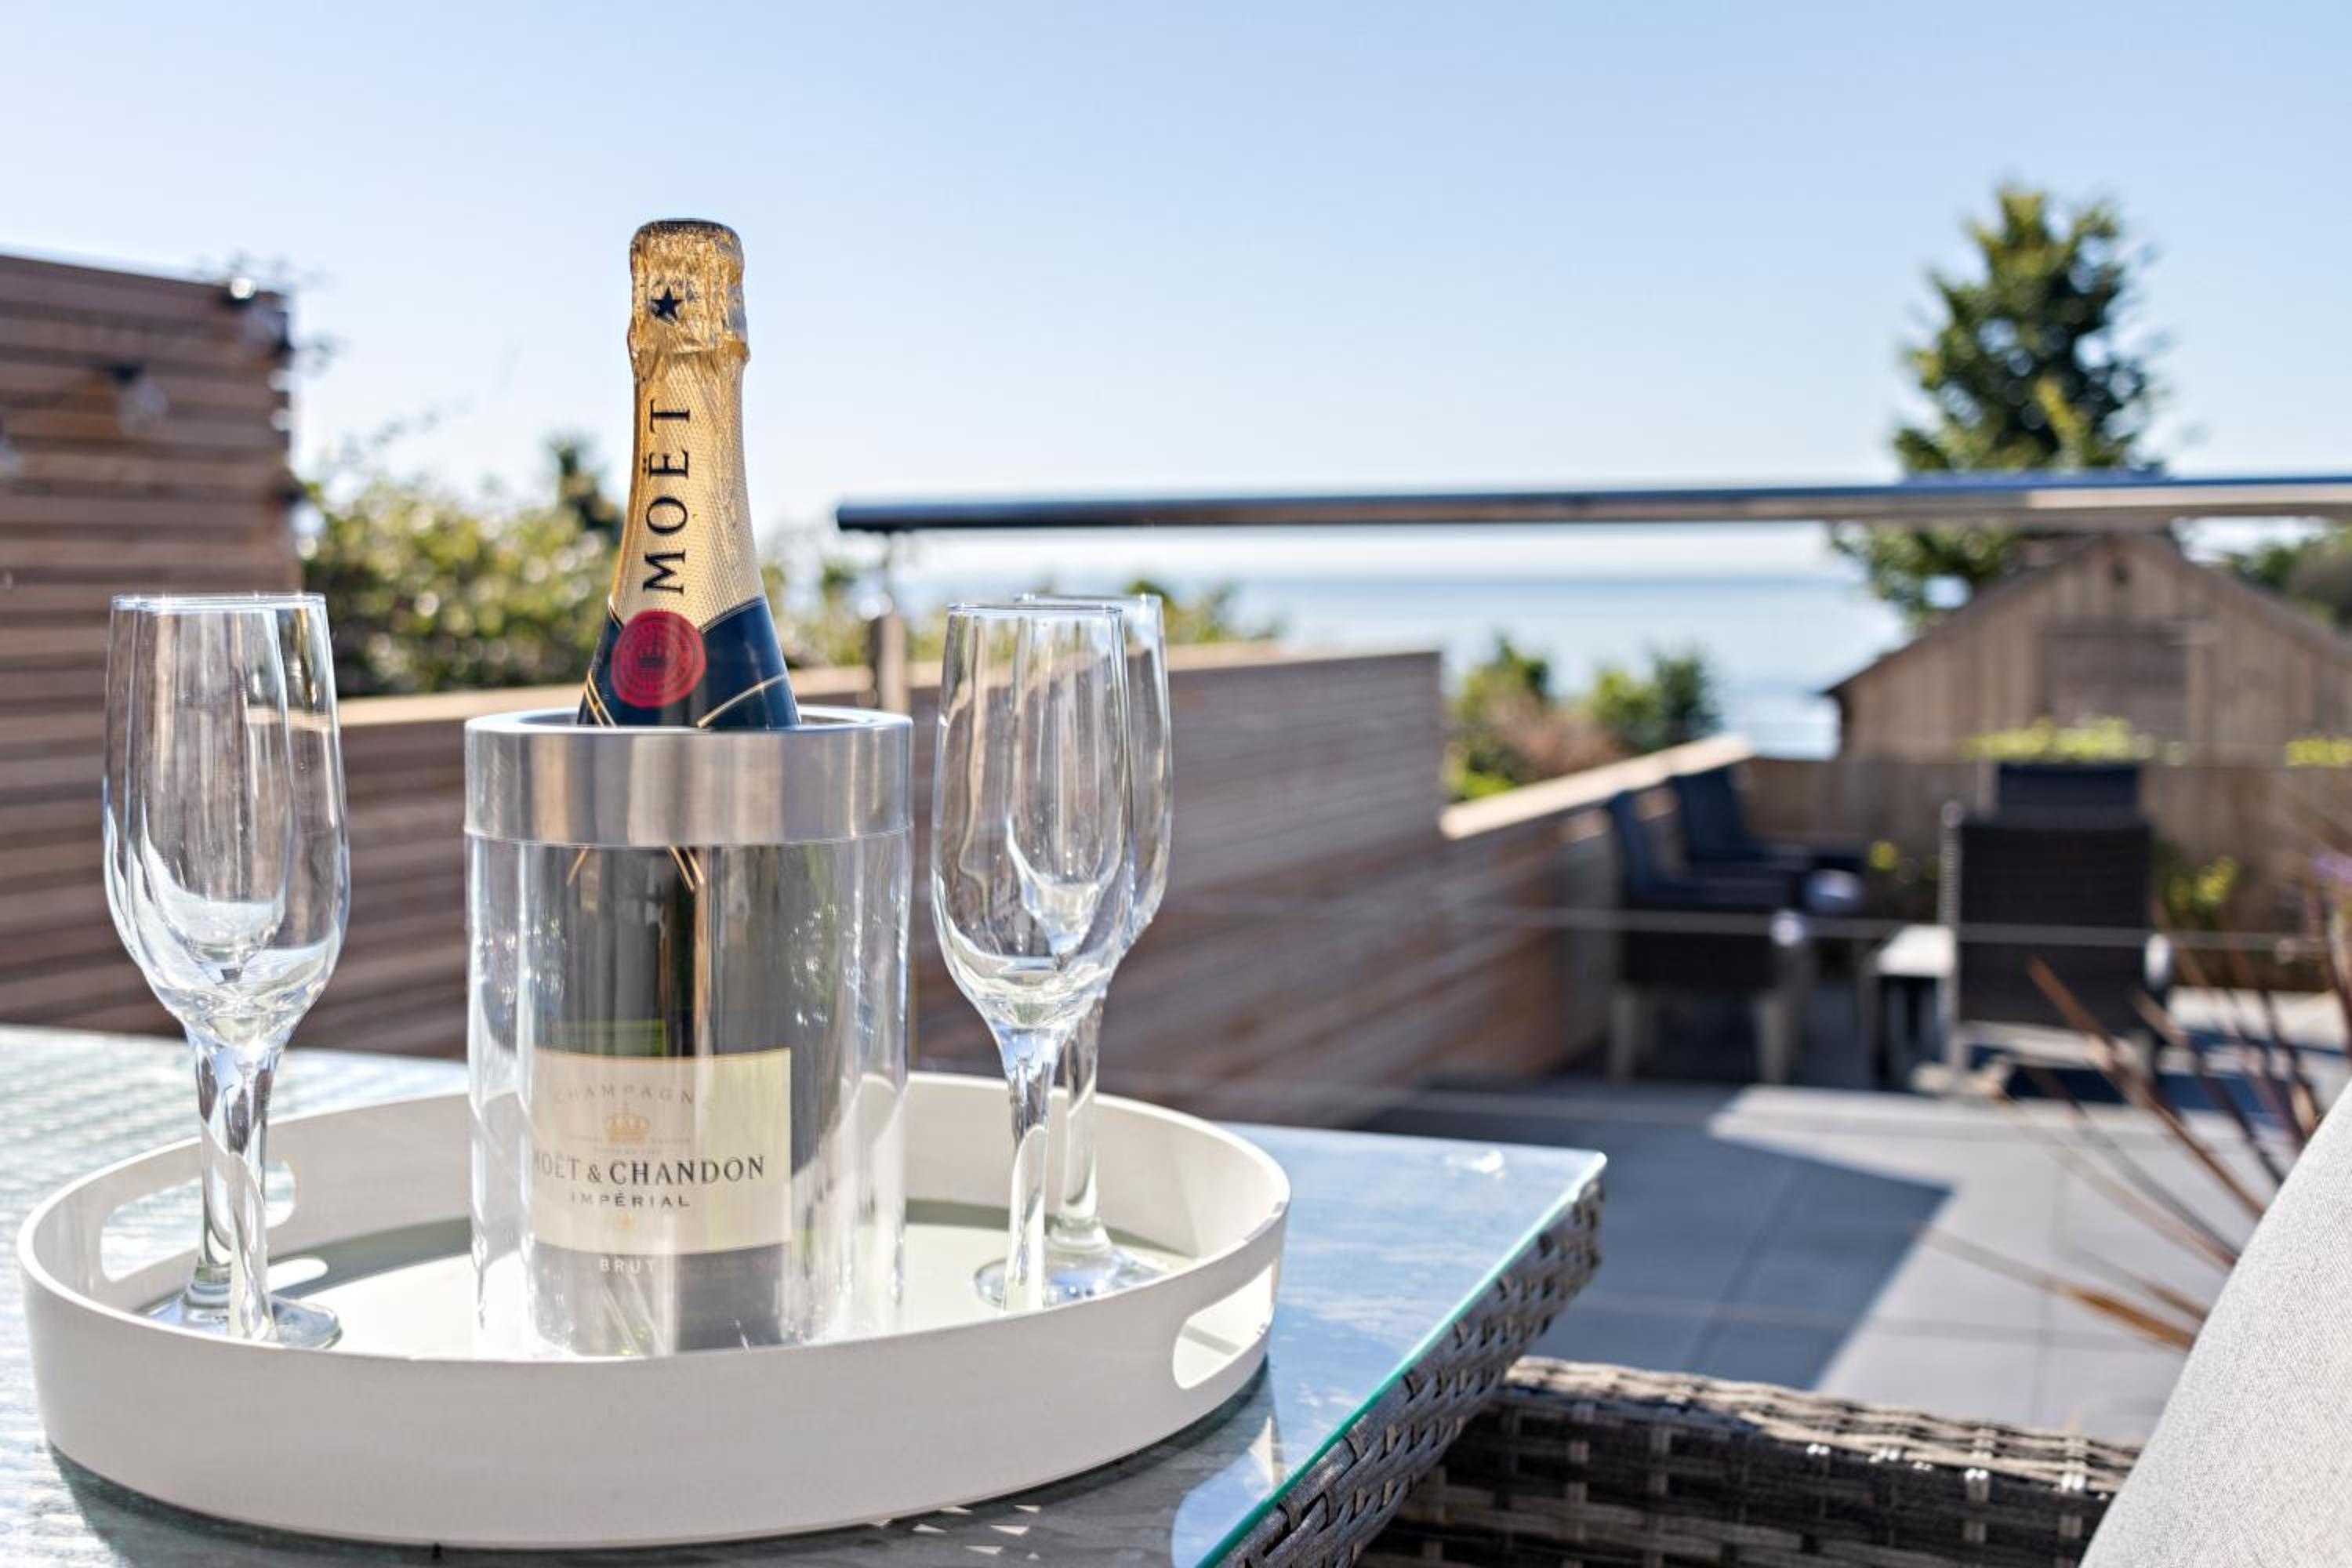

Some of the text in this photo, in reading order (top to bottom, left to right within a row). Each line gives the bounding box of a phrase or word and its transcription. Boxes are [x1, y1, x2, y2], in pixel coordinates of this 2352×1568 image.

[642, 399, 691, 594] MOËT
[587, 1163, 603, 1183] &
[609, 1156, 765, 1185] CHANDON
[571, 1190, 691, 1207] IMPÉRIAL
[600, 1258, 655, 1272] BRUT
